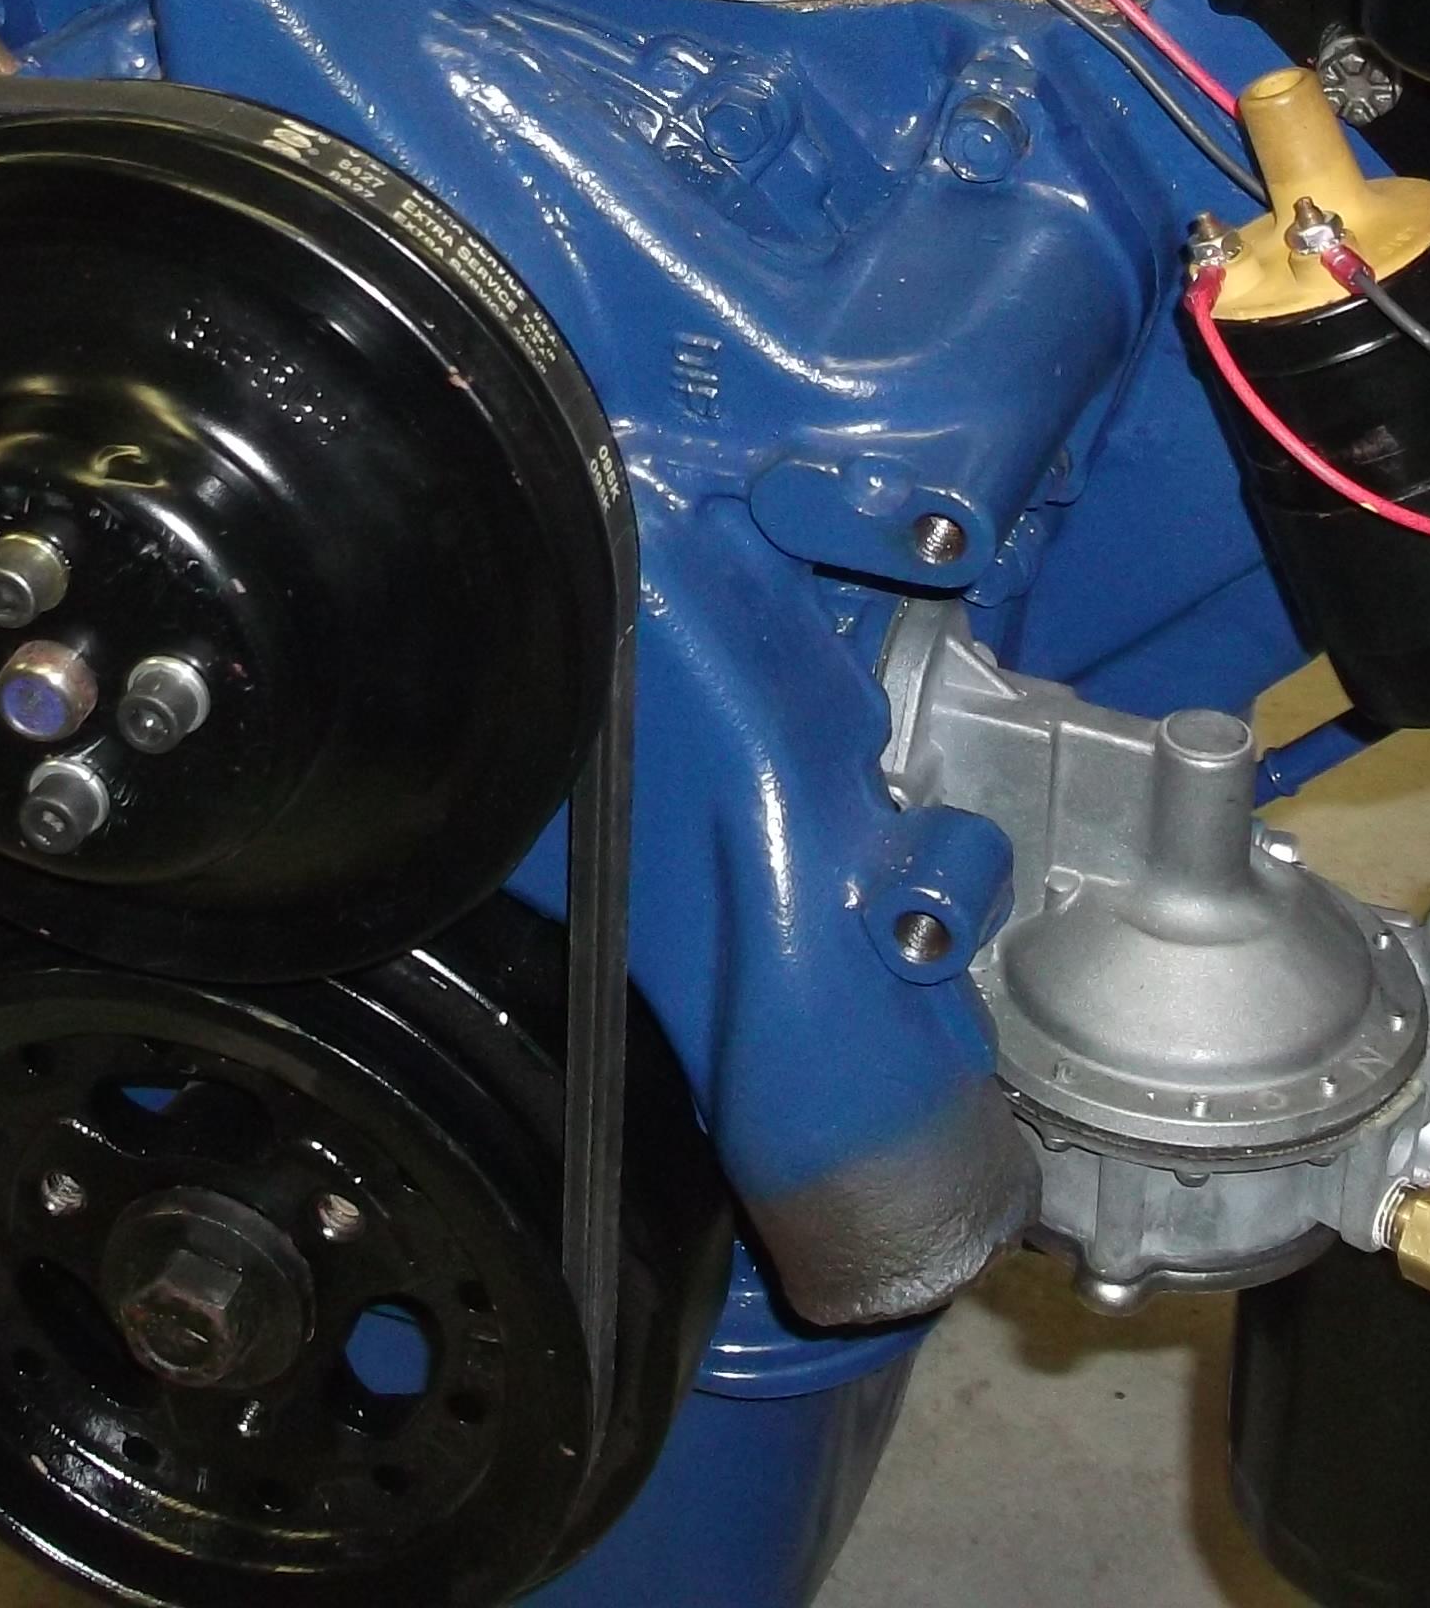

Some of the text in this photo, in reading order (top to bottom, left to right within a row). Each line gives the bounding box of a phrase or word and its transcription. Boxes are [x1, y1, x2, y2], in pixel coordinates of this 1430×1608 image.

[338, 158, 386, 189] 8427
[401, 198, 454, 248] EXTRA
[457, 245, 519, 314] SERVICE
[598, 445, 621, 502] 095K
